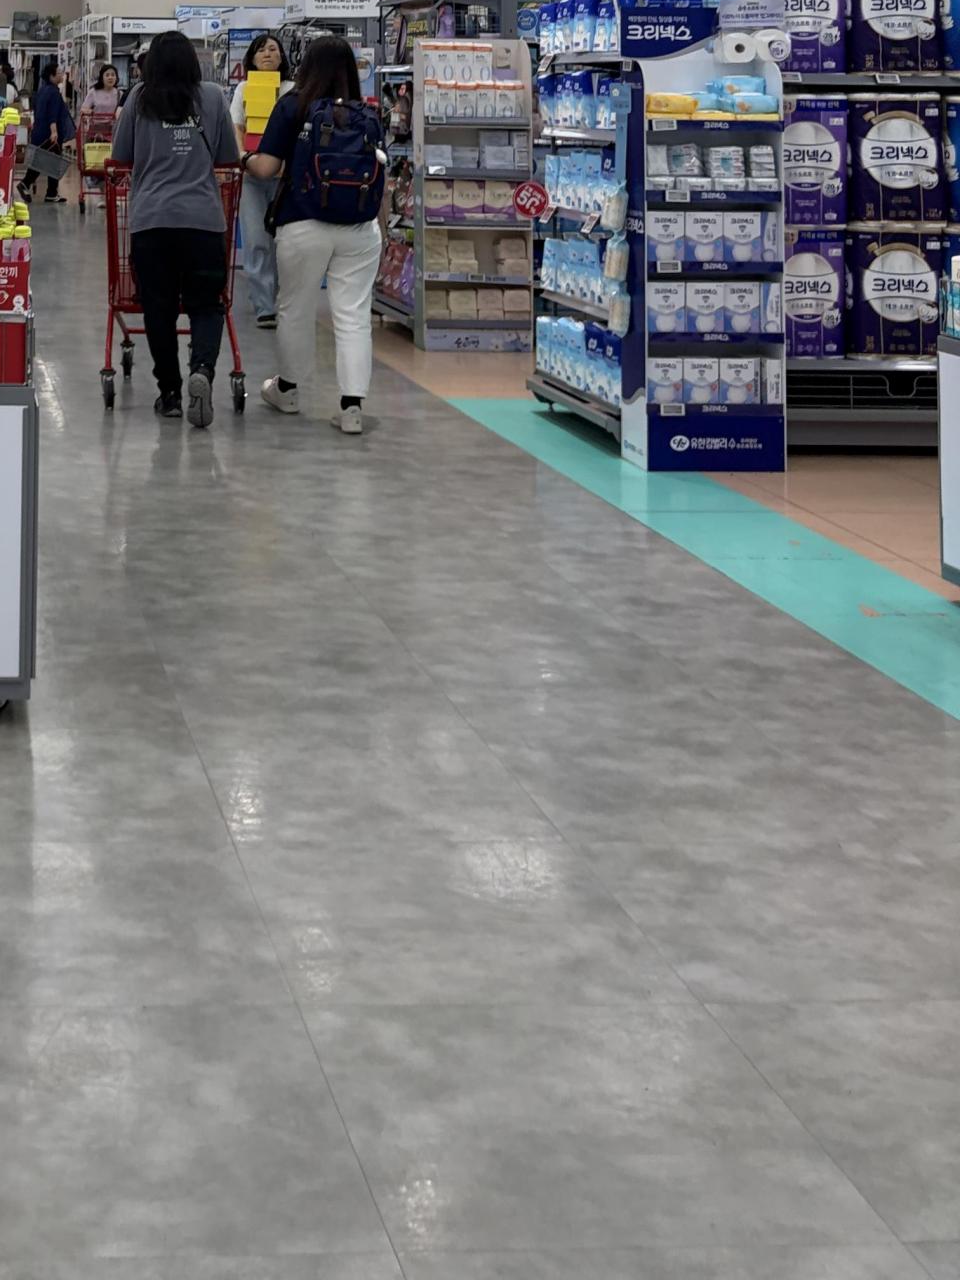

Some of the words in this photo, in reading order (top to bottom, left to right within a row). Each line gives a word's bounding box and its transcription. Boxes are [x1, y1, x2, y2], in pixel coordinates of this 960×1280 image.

[626, 24, 693, 41] 크리넥스
[784, 148, 833, 163] 크리넥스
[869, 145, 929, 161] 크리넥스
[784, 280, 832, 295] 크리넥스
[871, 277, 930, 294] 크리넥스
[691, 437, 728, 450] 유한킴벌리
